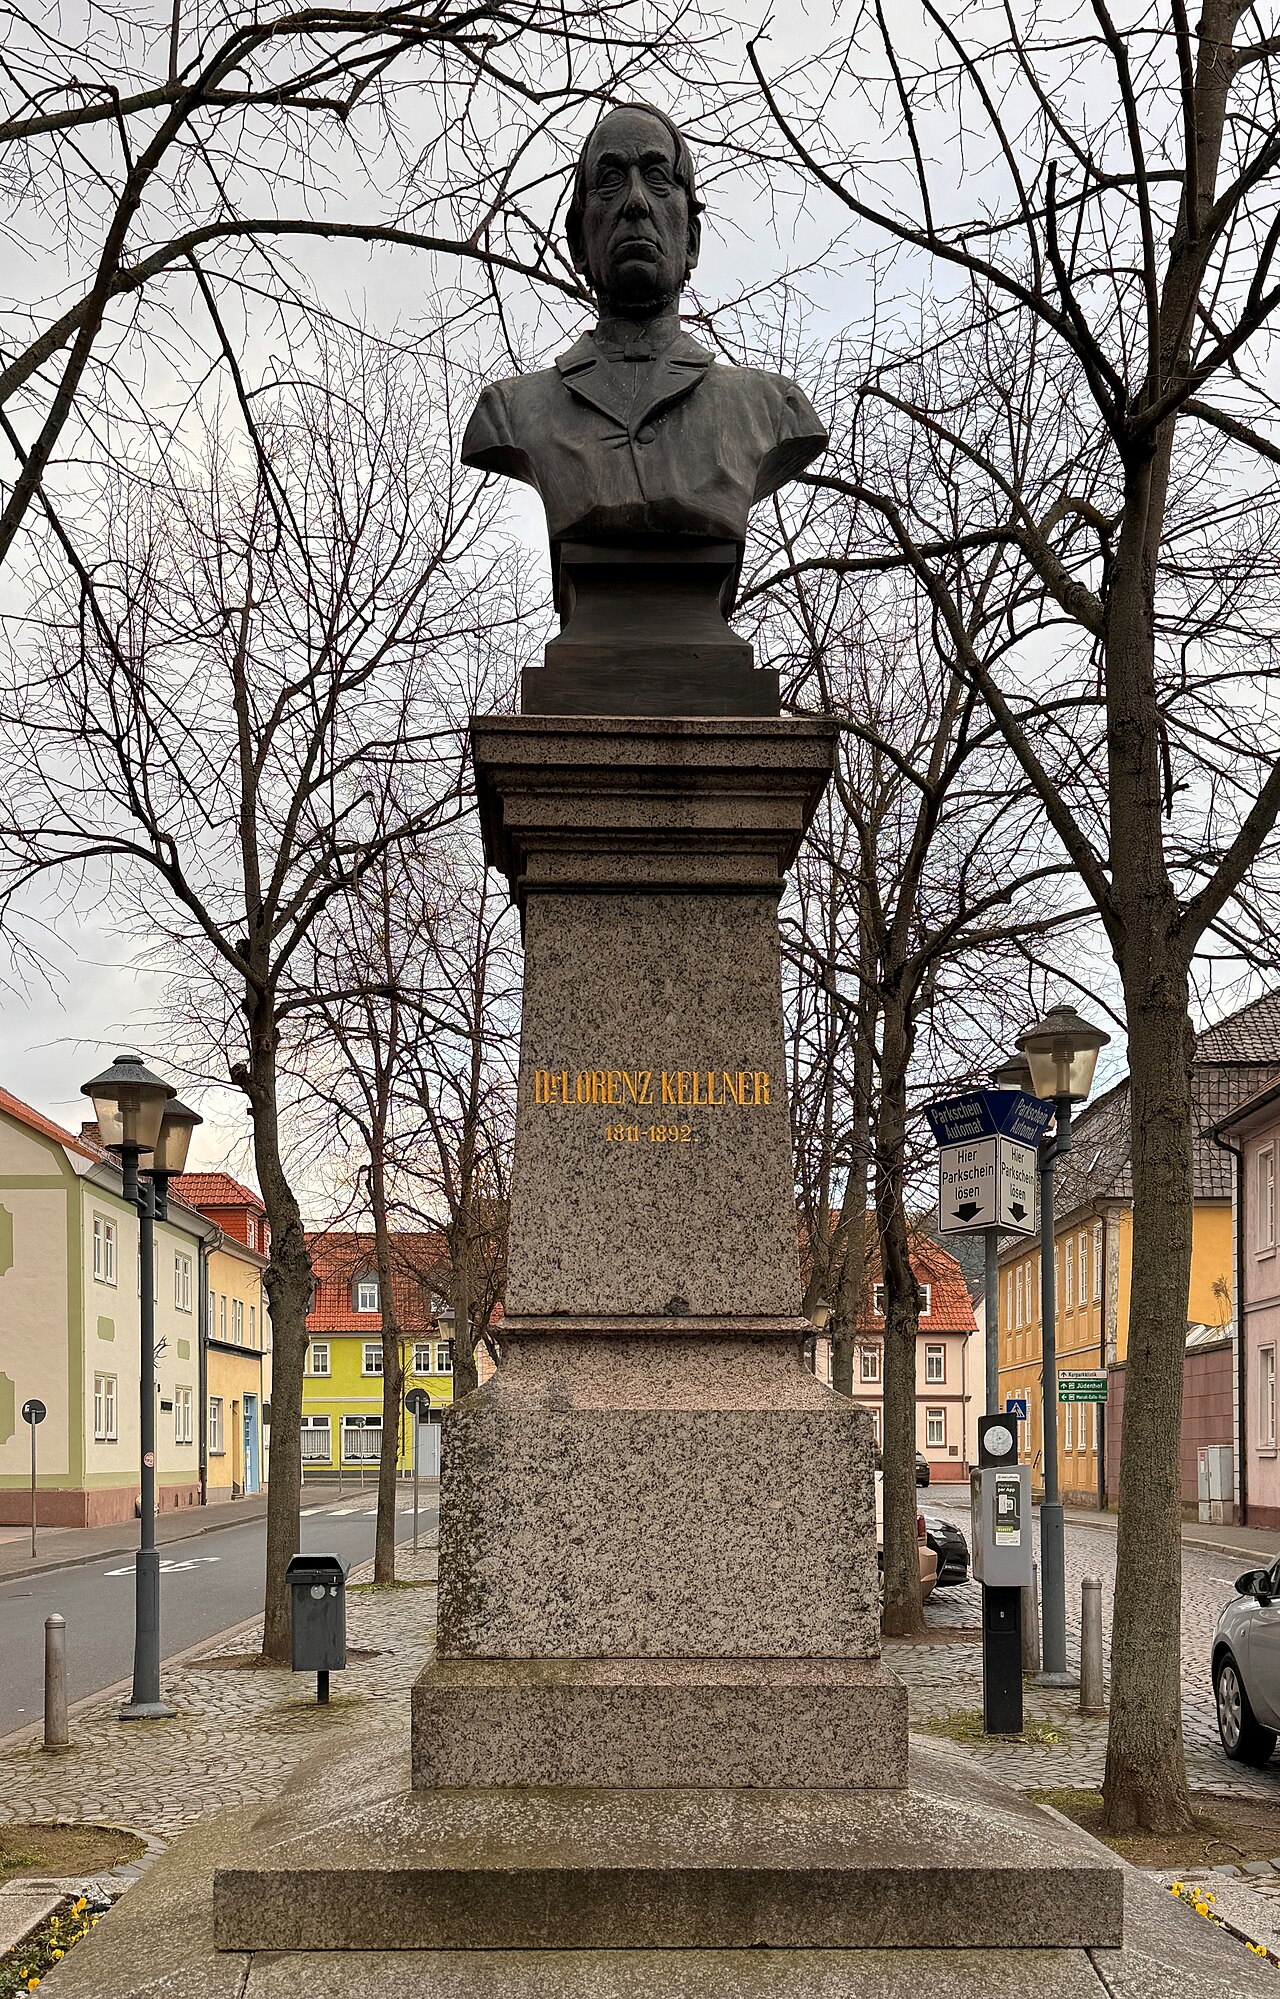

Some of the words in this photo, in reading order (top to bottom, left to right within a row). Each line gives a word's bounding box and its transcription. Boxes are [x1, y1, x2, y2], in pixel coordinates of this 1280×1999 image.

[561, 1070, 653, 1105] LORENZ
[661, 1071, 771, 1105] KELLNER
[931, 1099, 983, 1125] Parkschein
[1014, 1098, 1049, 1126] Parkschein
[945, 1117, 984, 1140] Automat
[1010, 1118, 1038, 1141] Automat
[957, 1149, 978, 1164] Hier
[1011, 1146, 1025, 1164] Hier
[942, 1163, 994, 1186] Parkschein
[1001, 1161, 1034, 1186] Parkschein
[955, 1185, 980, 1201] lösen
[1009, 1183, 1026, 1201] lösen
